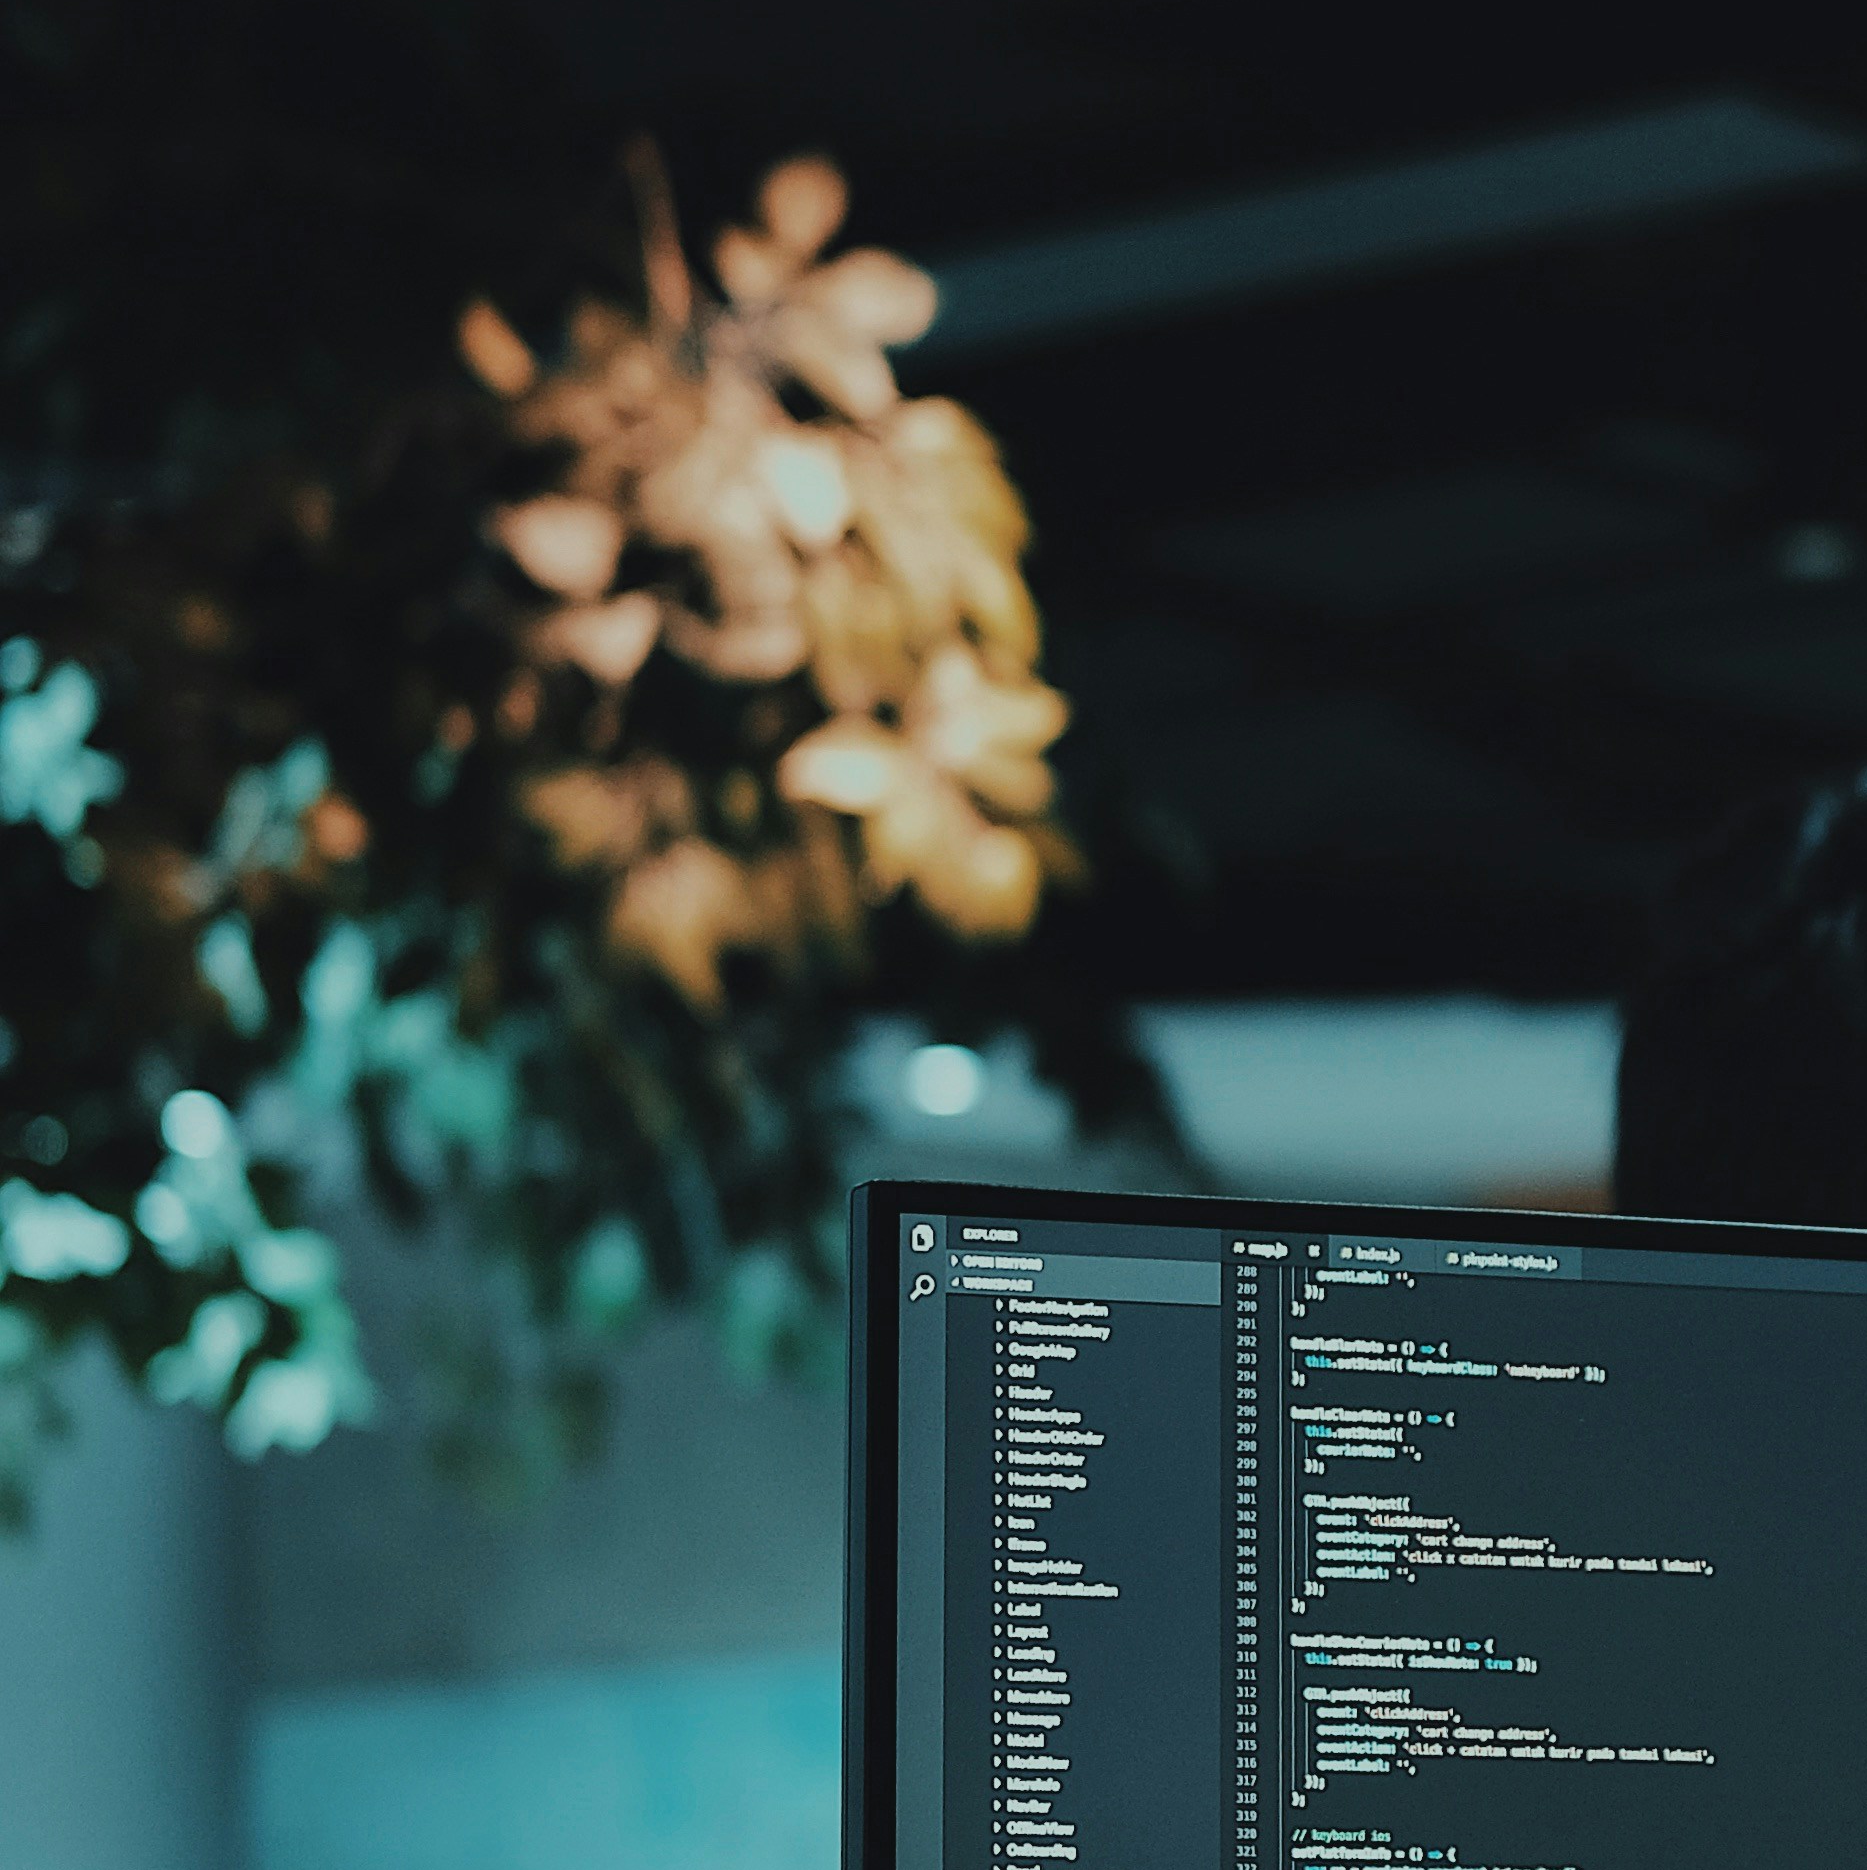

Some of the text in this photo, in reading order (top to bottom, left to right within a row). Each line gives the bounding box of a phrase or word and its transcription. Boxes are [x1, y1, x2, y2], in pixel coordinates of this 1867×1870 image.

[963, 1228, 1018, 1242] EXPLORER
[1356, 1246, 1400, 1263] index.js
[1462, 1251, 1558, 1272] pinpoint-styles.js
[1236, 1265, 1258, 1278] 288
[1236, 1300, 1258, 1313] 290
[1236, 1335, 1257, 1347] 292
[1236, 1369, 1257, 1382] 294
[1236, 1404, 1257, 1417] 296
[1236, 1440, 1257, 1452] 298
[1236, 1510, 1257, 1522] 302
[1236, 1545, 1257, 1557] 304
[1236, 1580, 1257, 1592] 306
[1236, 1650, 1257, 1663] 310
[1236, 1686, 1257, 1698] 312
[1236, 1721, 1257, 1734] 314
[1236, 1756, 1257, 1769] 316
[1236, 1792, 1258, 1804] 318
[1236, 1827, 1257, 1840] 320
[1312, 1829, 1365, 1843] keyboard
[1371, 1830, 1391, 1842] ios
